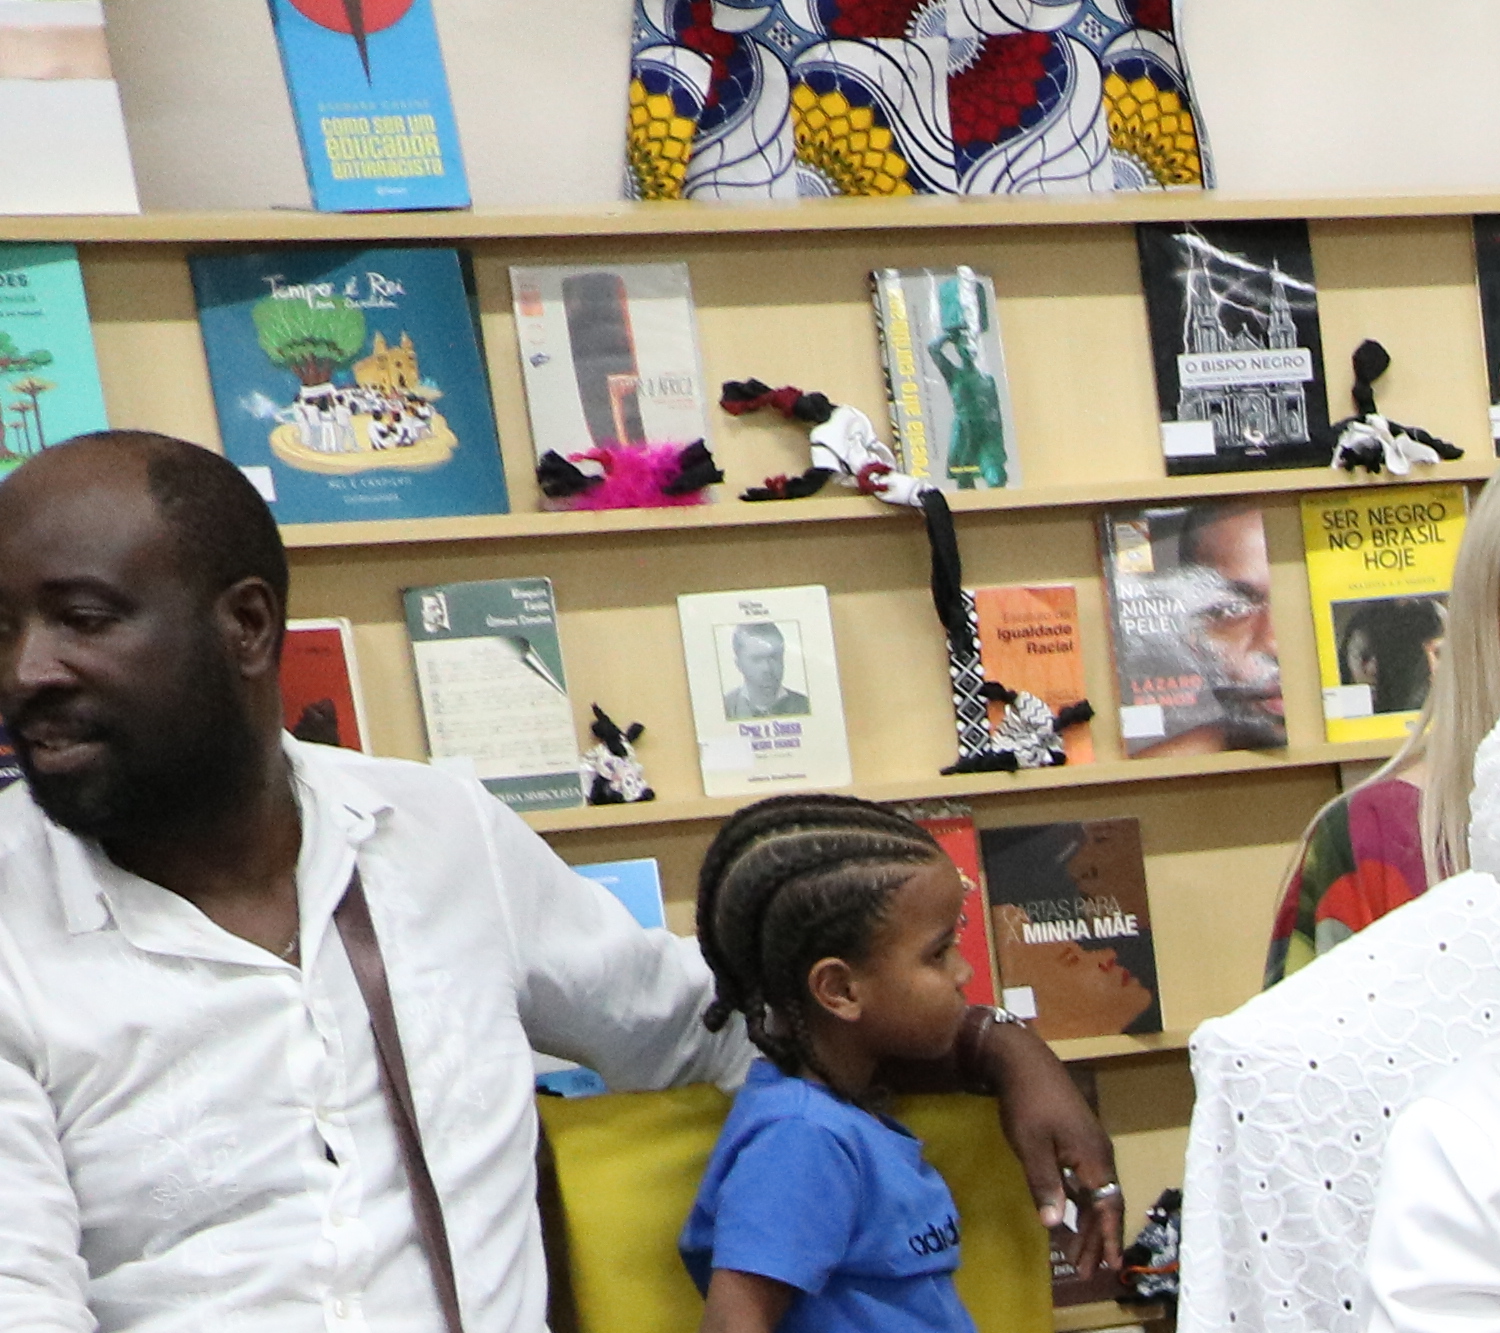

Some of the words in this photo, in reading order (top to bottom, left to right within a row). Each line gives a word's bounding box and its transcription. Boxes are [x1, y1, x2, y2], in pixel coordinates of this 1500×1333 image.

[1185, 361, 1198, 374] O
[1202, 358, 1247, 372] BISPO
[1251, 355, 1305, 370] NEGRO
[1321, 508, 1359, 530] SER
[1368, 502, 1446, 526] NEGRO
[1328, 531, 1363, 552] NO
[1372, 523, 1446, 548] BRASIL
[1364, 547, 1416, 571] HOJE
[1120, 582, 1147, 599] NA
[1121, 599, 1187, 618] MINHA
[997, 623, 1073, 643] Igualdade
[1124, 615, 1174, 635] PELE
[1026, 639, 1074, 654] Racial
[1022, 917, 1091, 945] MINHA
[1093, 911, 1139, 939] MÃE
[908, 1213, 959, 1257] adid
